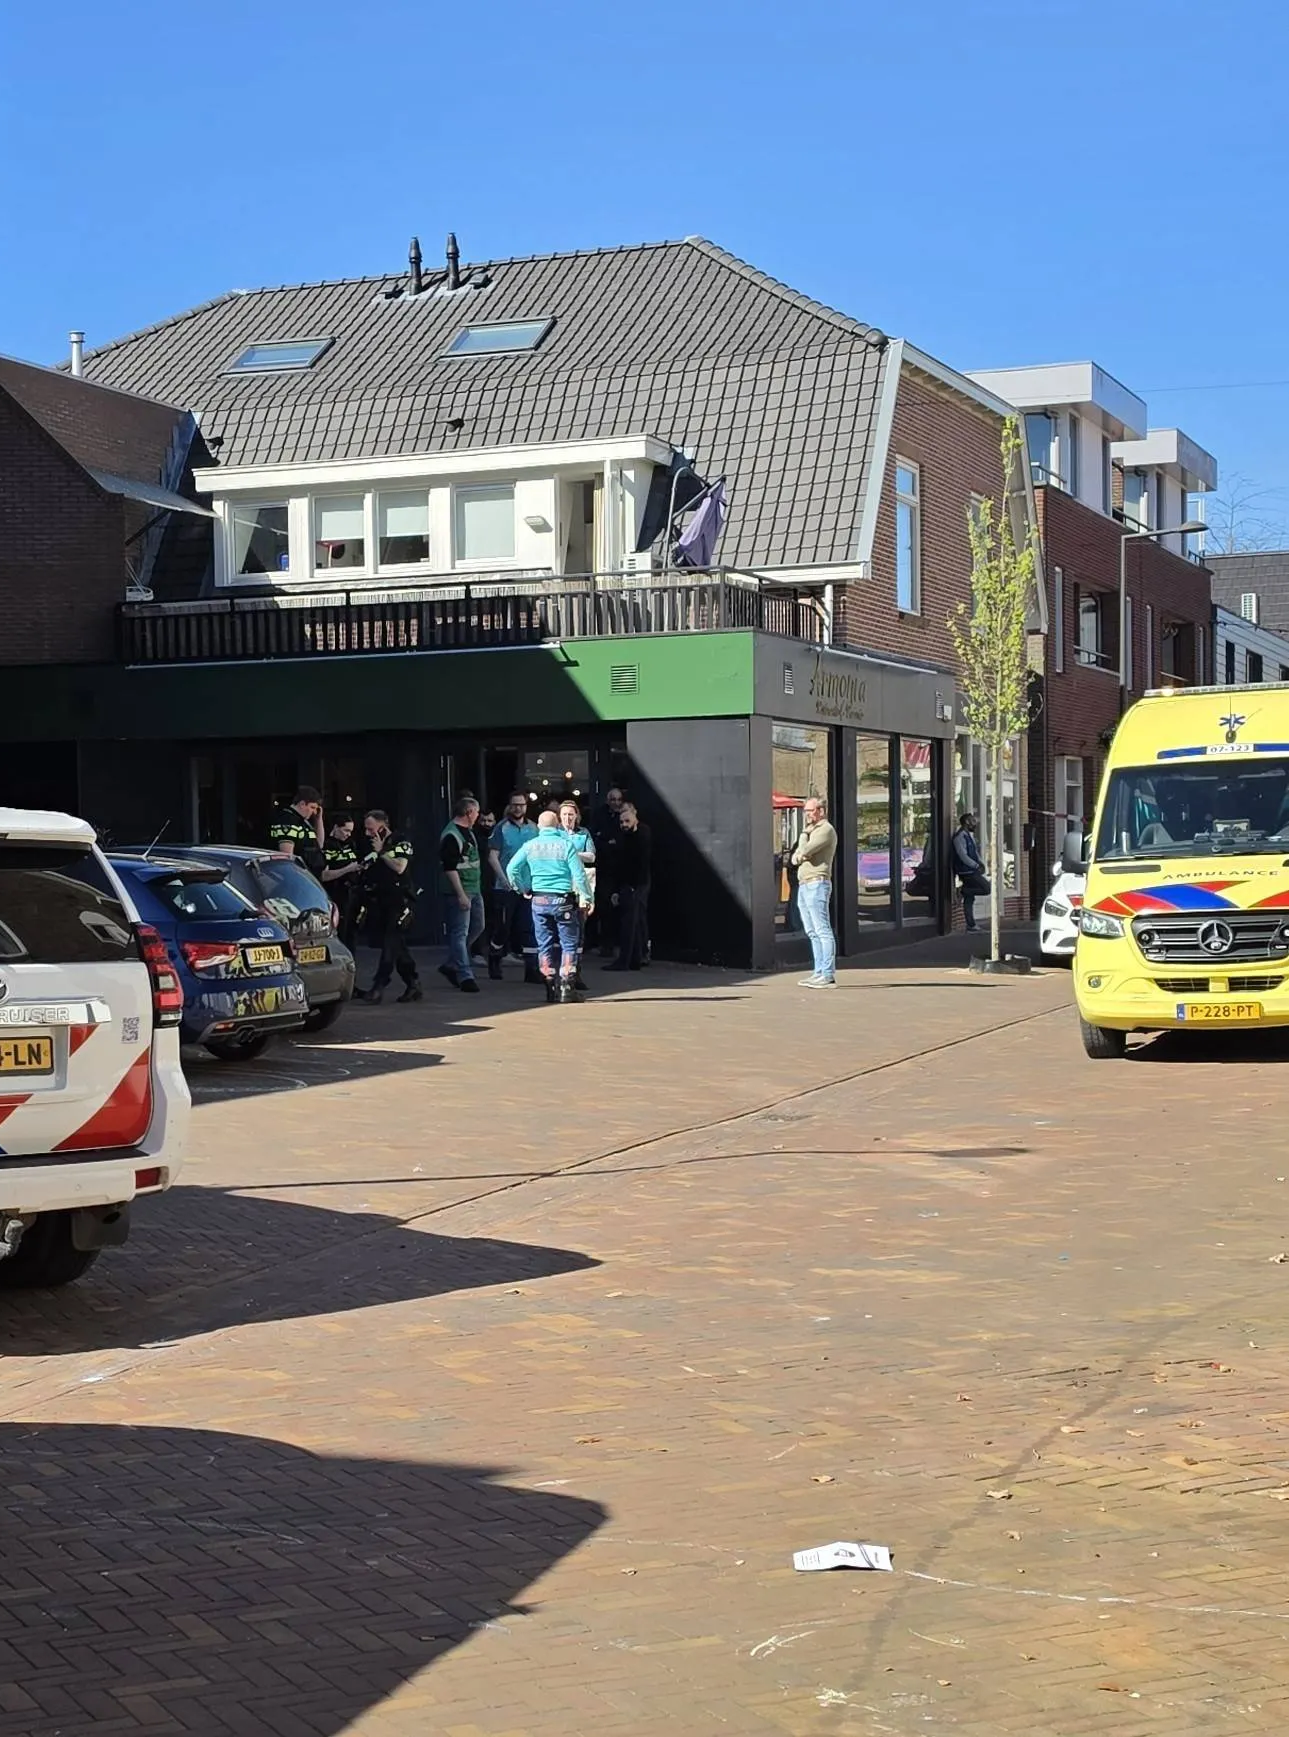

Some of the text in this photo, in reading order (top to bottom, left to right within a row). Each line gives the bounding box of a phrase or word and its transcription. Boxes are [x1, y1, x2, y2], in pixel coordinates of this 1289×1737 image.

[1210, 745, 1250, 753] 07-123
[1163, 870, 1278, 879] AMBULANCE
[1190, 1005, 1254, 1018] P-228-PT
